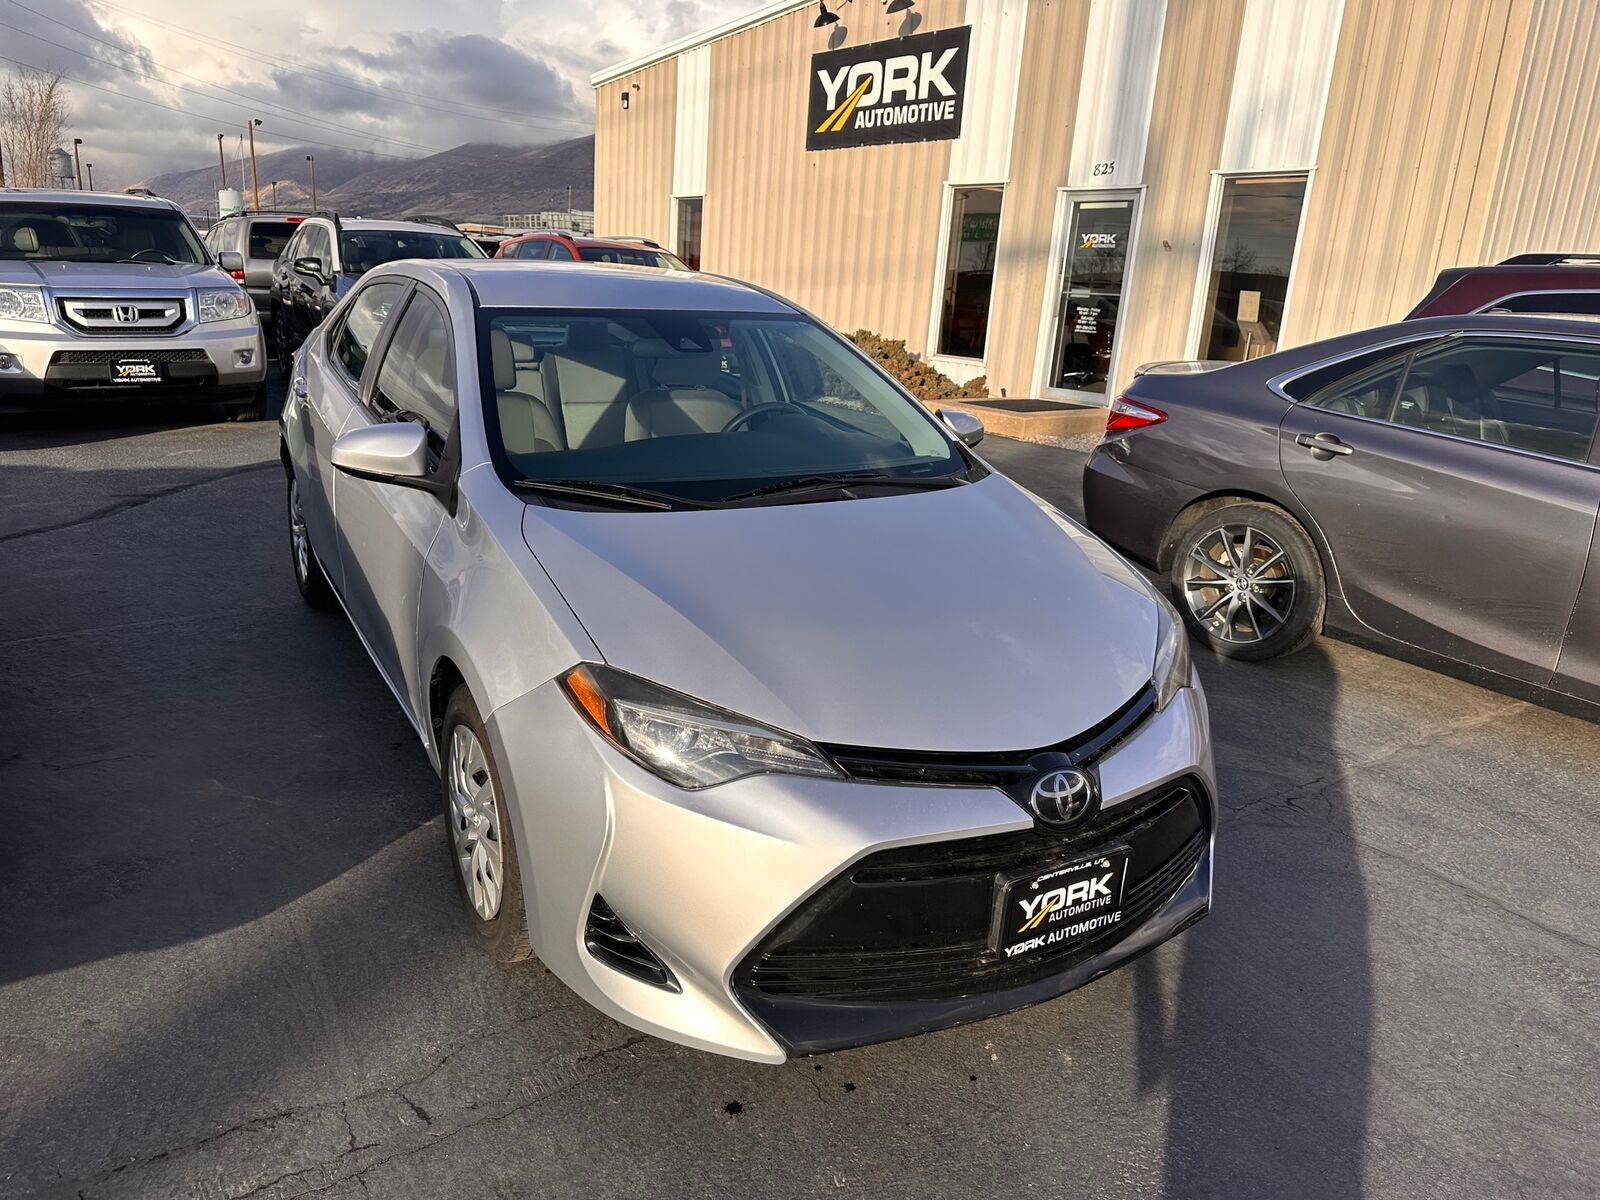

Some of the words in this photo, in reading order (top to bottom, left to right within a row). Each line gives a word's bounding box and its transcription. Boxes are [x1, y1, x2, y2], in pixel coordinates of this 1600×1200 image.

[817, 47, 959, 111] YORK
[854, 100, 956, 129] AUTOMOTIVE
[1093, 161, 1115, 176] 825
[1081, 233, 1117, 244] YORK
[115, 364, 155, 373] YORK
[1094, 857, 1107, 866] UT
[1018, 872, 1114, 920] YORK
[1048, 895, 1112, 923] AUTOMOTIVE
[1004, 934, 1046, 958] YORK
[1047, 911, 1122, 945] AUTOMOTIVE
